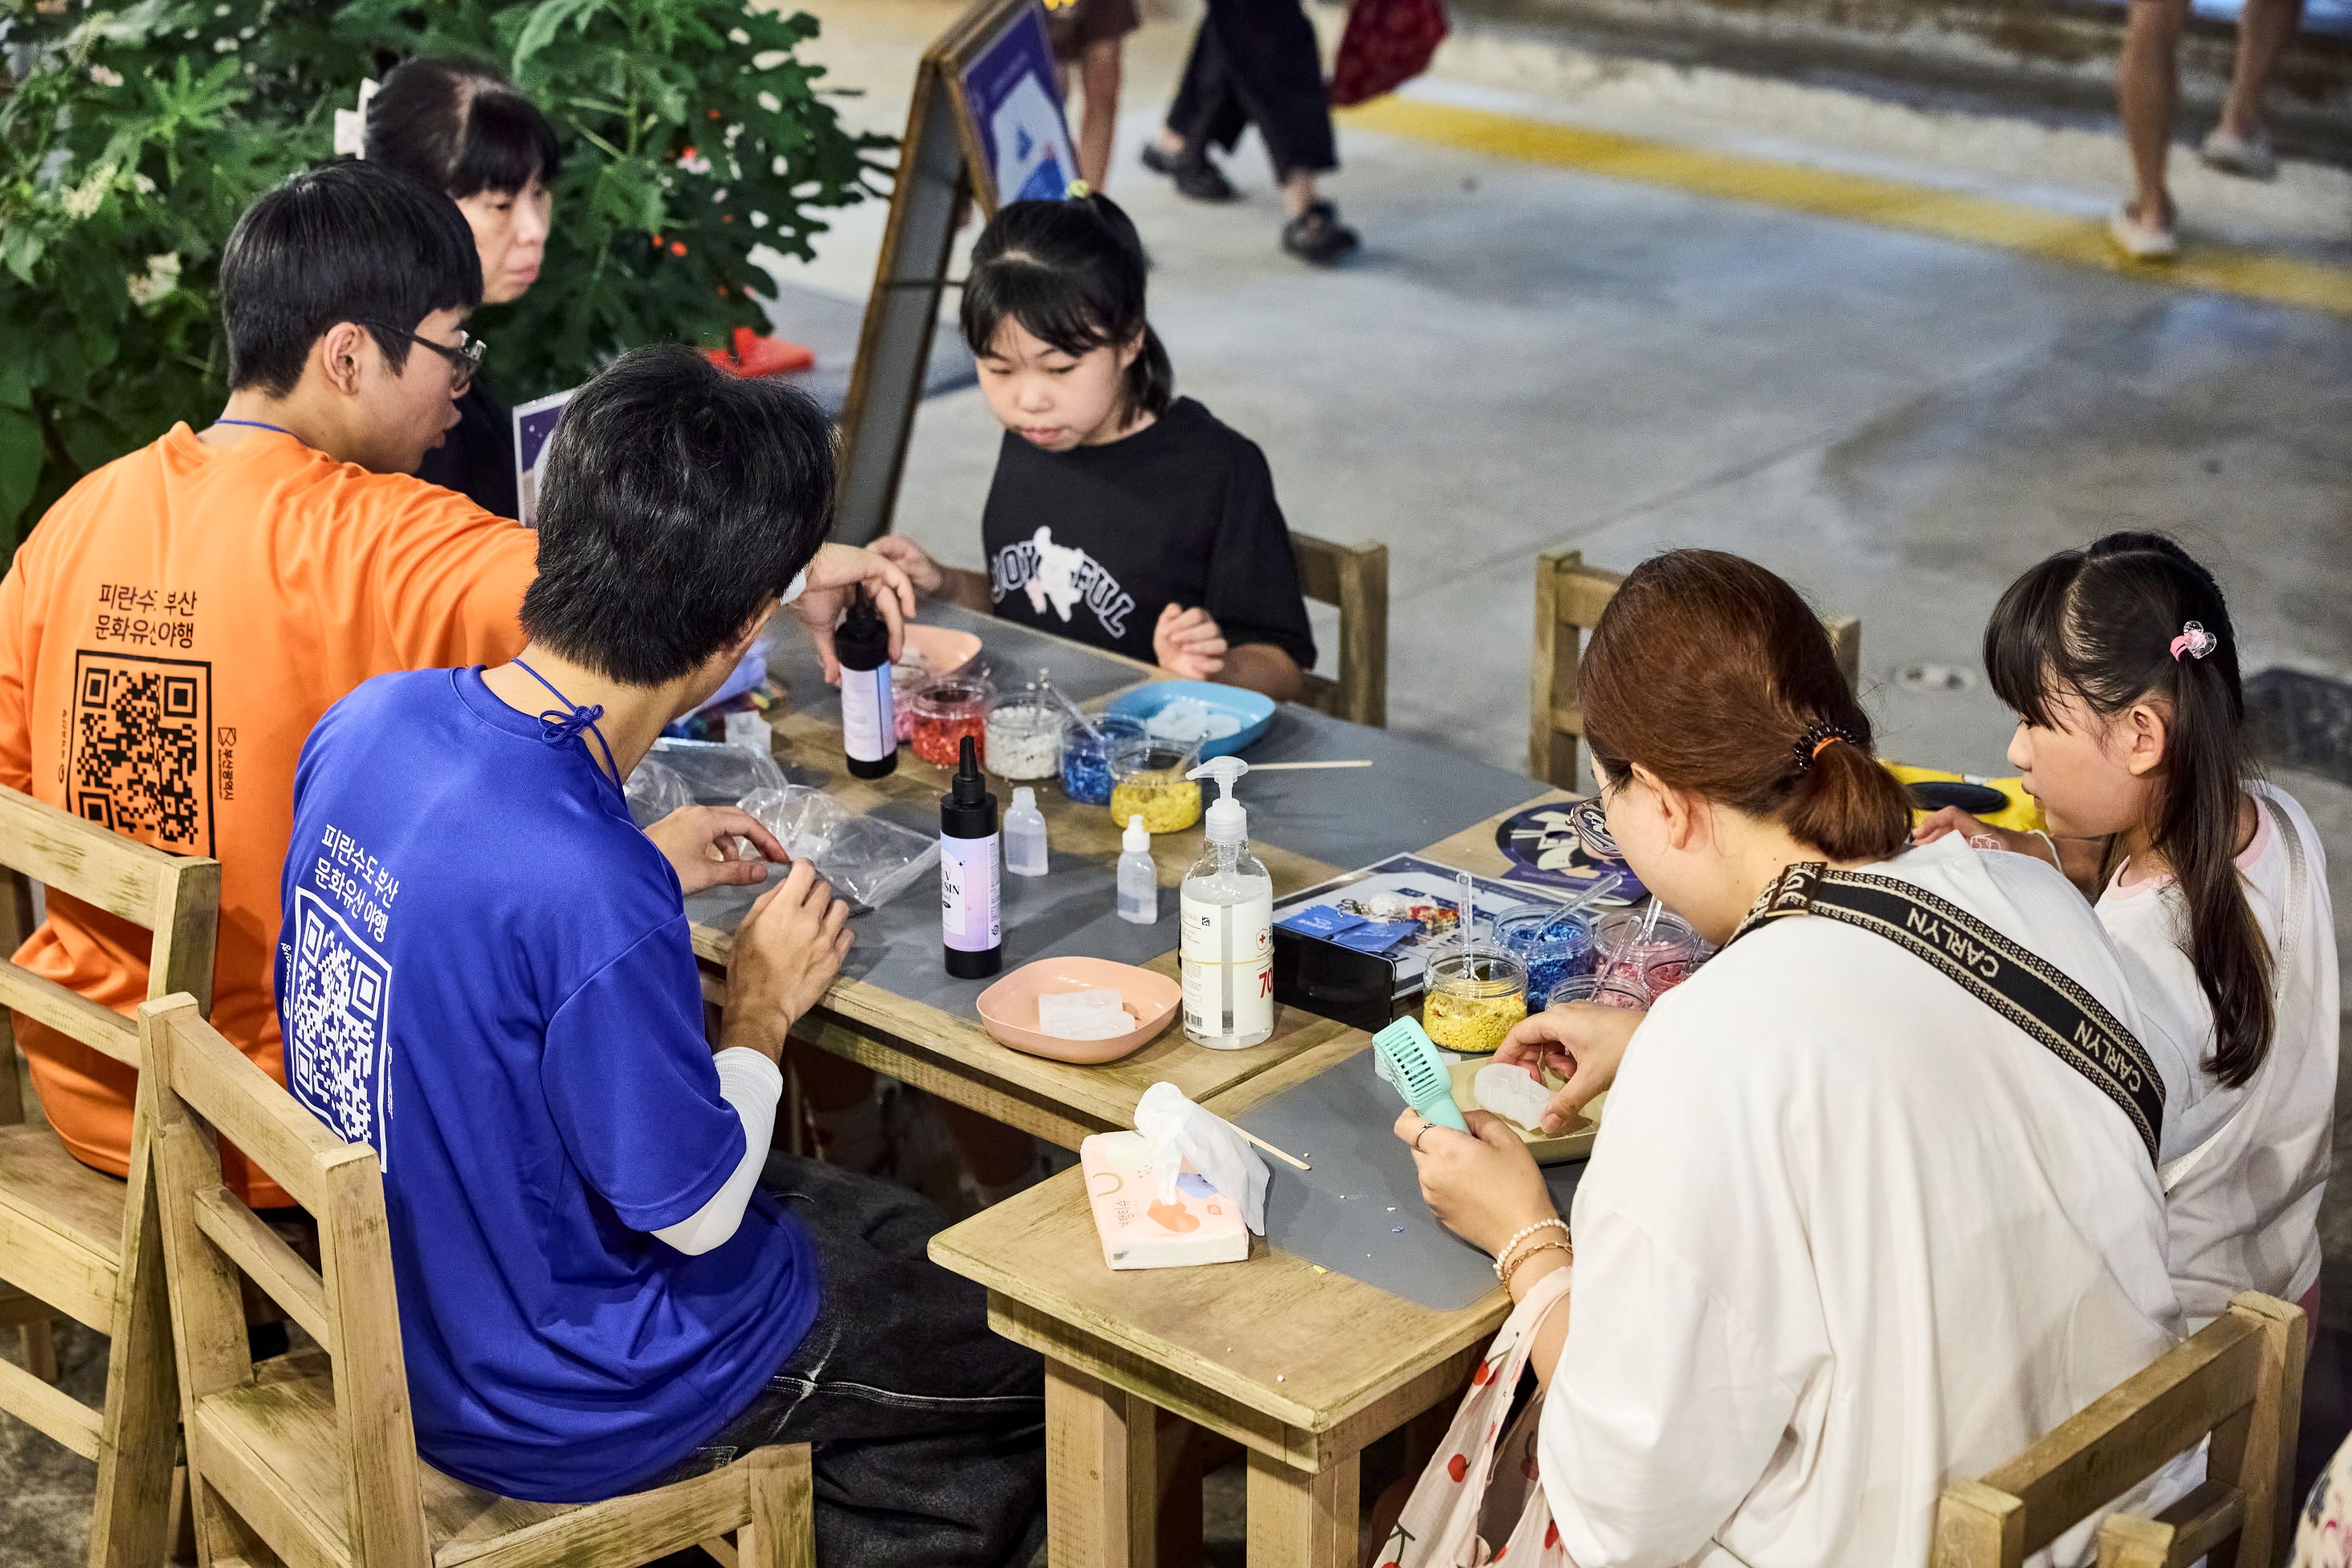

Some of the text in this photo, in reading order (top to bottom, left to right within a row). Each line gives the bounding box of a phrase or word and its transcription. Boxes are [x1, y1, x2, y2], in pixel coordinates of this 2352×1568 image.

[98, 584, 198, 617] 피란수 부산
[222, 748, 234, 800] 부산광역시
[315, 857, 389, 943] 문화유산 야행
[321, 824, 399, 909] 피란수도 부산
[1906, 907, 1999, 978] CARLYN
[2073, 1020, 2142, 1093] CARLYN
